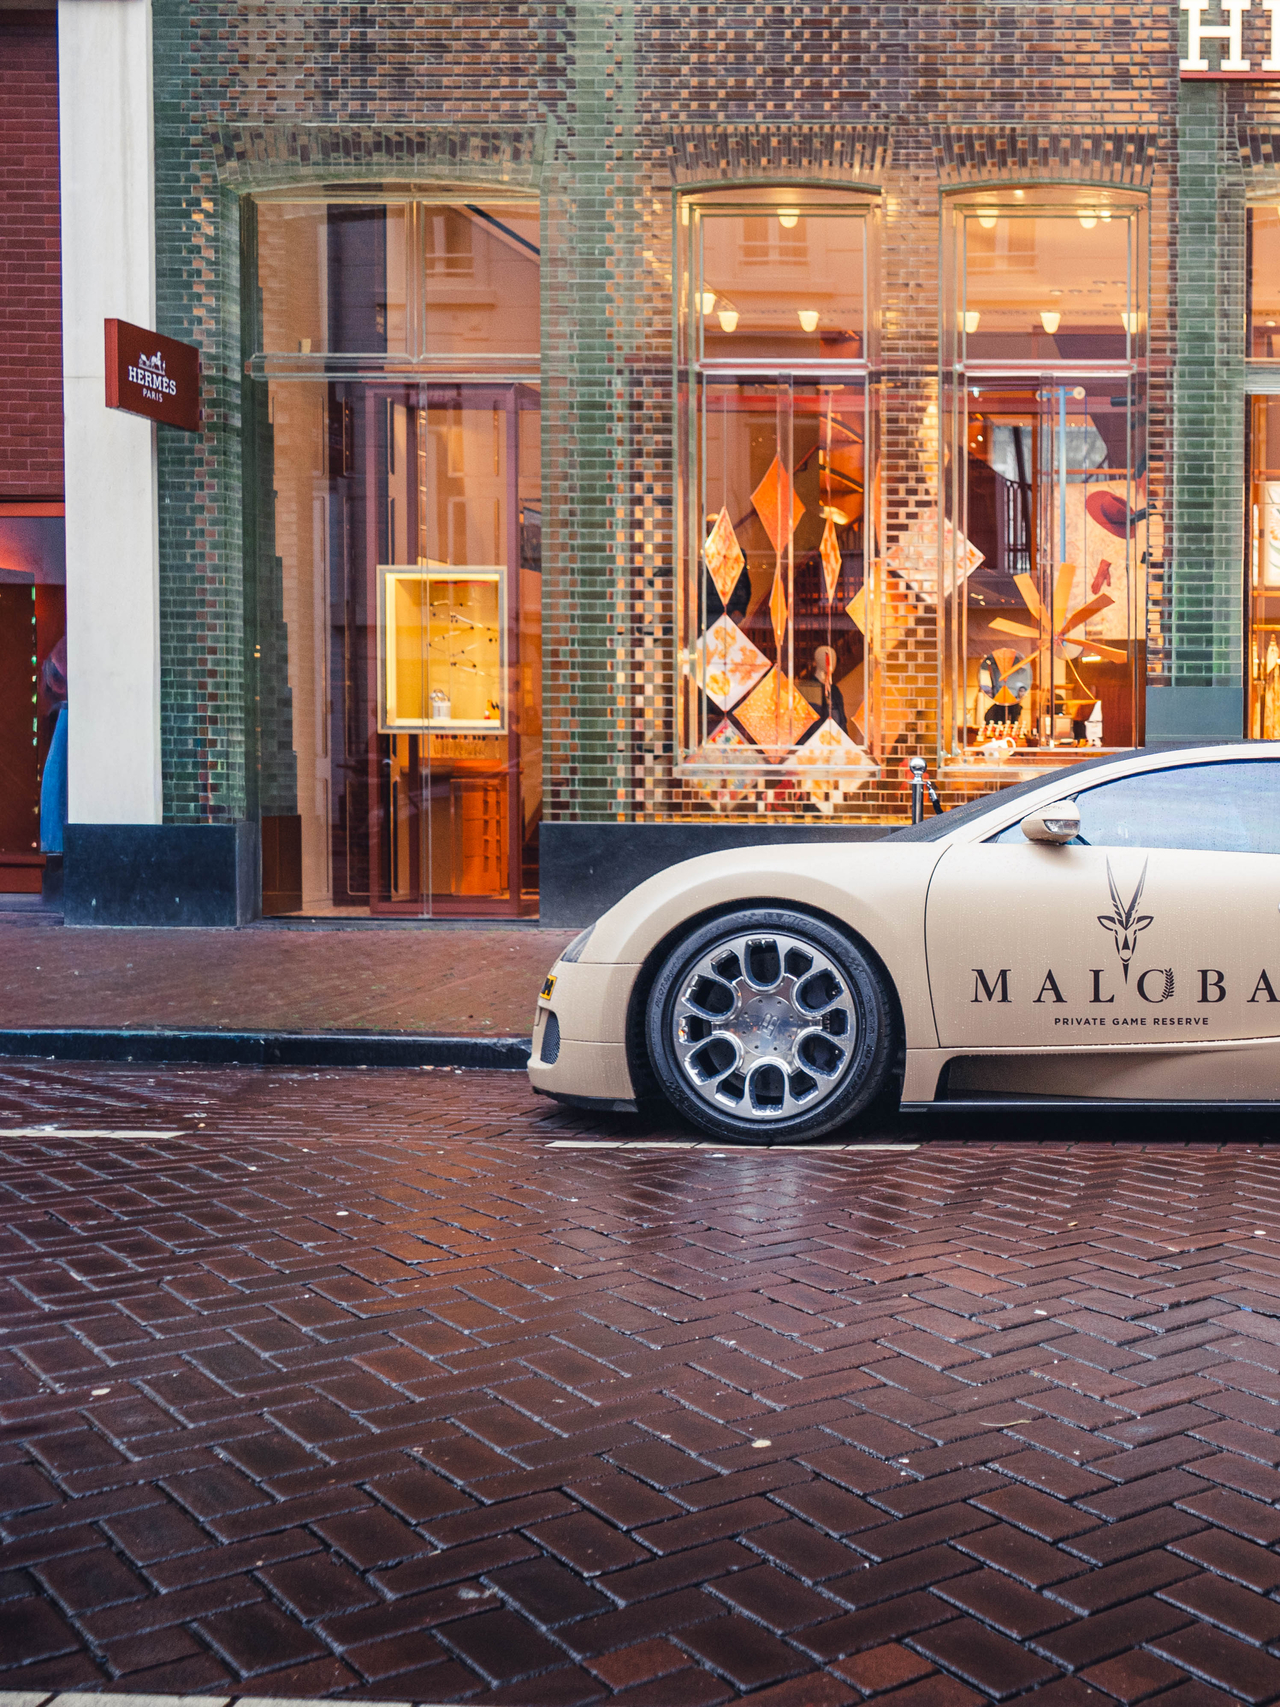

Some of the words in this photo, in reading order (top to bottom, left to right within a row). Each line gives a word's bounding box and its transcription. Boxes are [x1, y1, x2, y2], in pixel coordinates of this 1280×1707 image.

[142, 388, 163, 403] PARIS
[1054, 1017, 1106, 1026] PRIVATE
[1112, 1017, 1147, 1026] GAME
[1153, 1017, 1209, 1026] RESERVE
